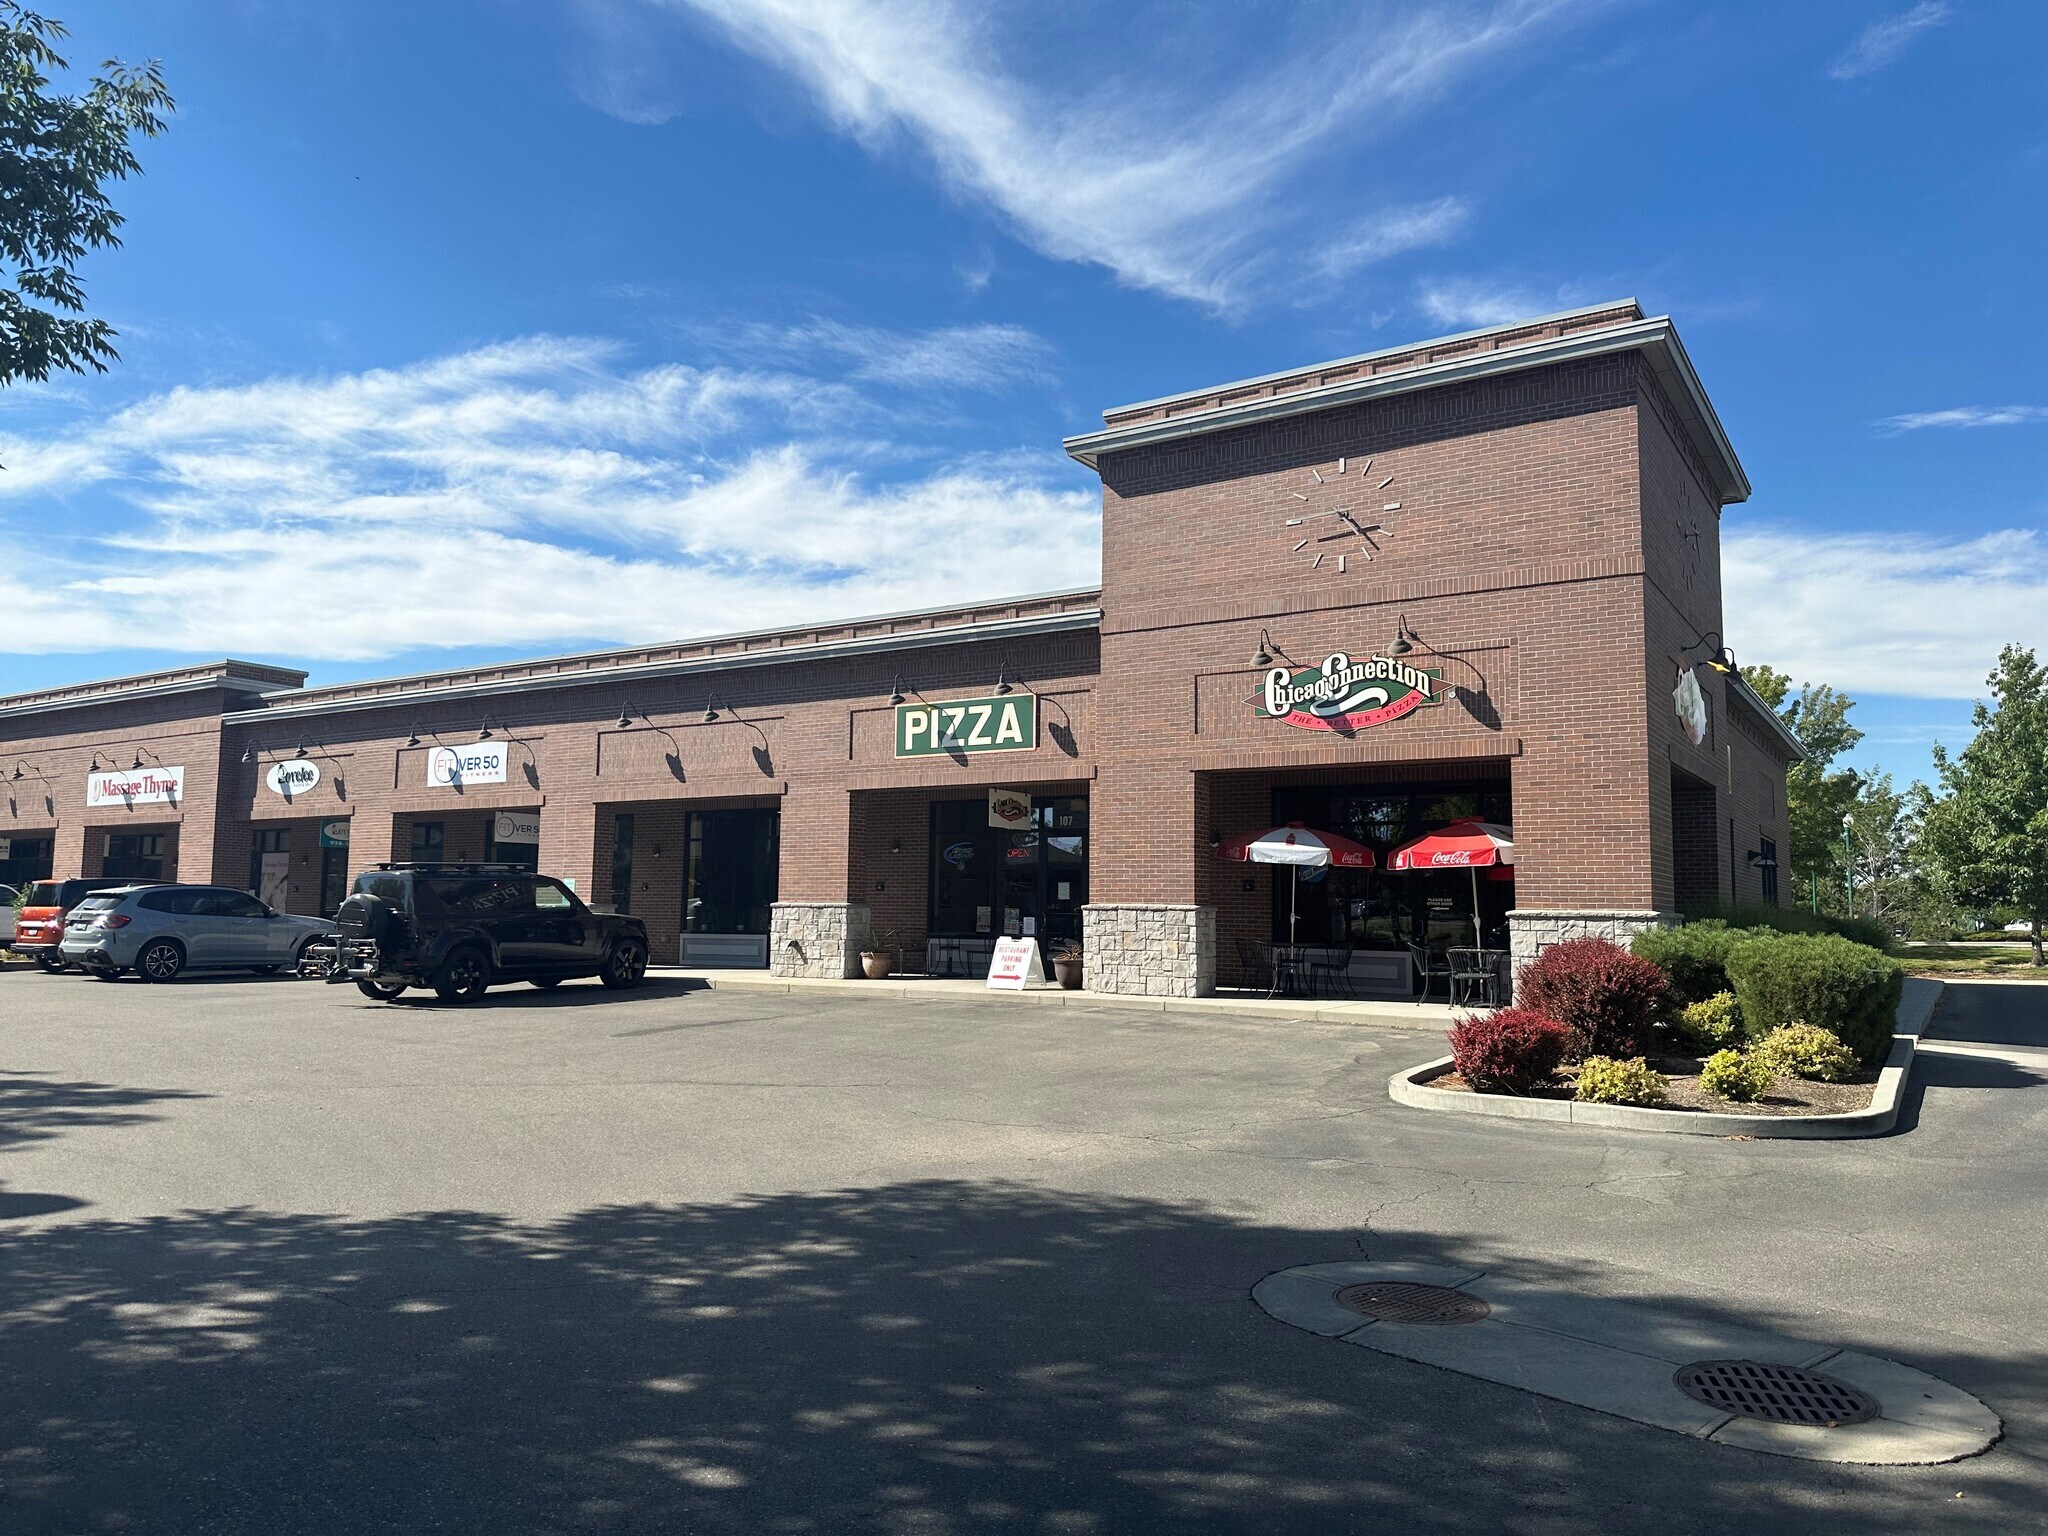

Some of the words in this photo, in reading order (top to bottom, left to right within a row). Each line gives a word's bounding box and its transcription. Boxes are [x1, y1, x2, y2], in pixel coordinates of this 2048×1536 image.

[1319, 652, 1432, 706] Connection
[1293, 714, 1312, 725] THE
[1327, 715, 1372, 727] BETTER
[1385, 696, 1419, 717] PIZZA
[904, 702, 1023, 750] PIZZA
[437, 759, 455, 773] FIT
[483, 755, 499, 769] 50
[102, 779, 142, 800] Massage
[143, 775, 178, 799] Thyme
[1059, 816, 1074, 826] 107
[1007, 848, 1029, 858] OPEN
[1342, 852, 1363, 864] Coca-Cola
[1431, 851, 1471, 865] Coca-Cola
[998, 946, 1030, 954] RESTAURANT
[1001, 955, 1022, 963] PARKING
[1003, 964, 1016, 972] ONLY
